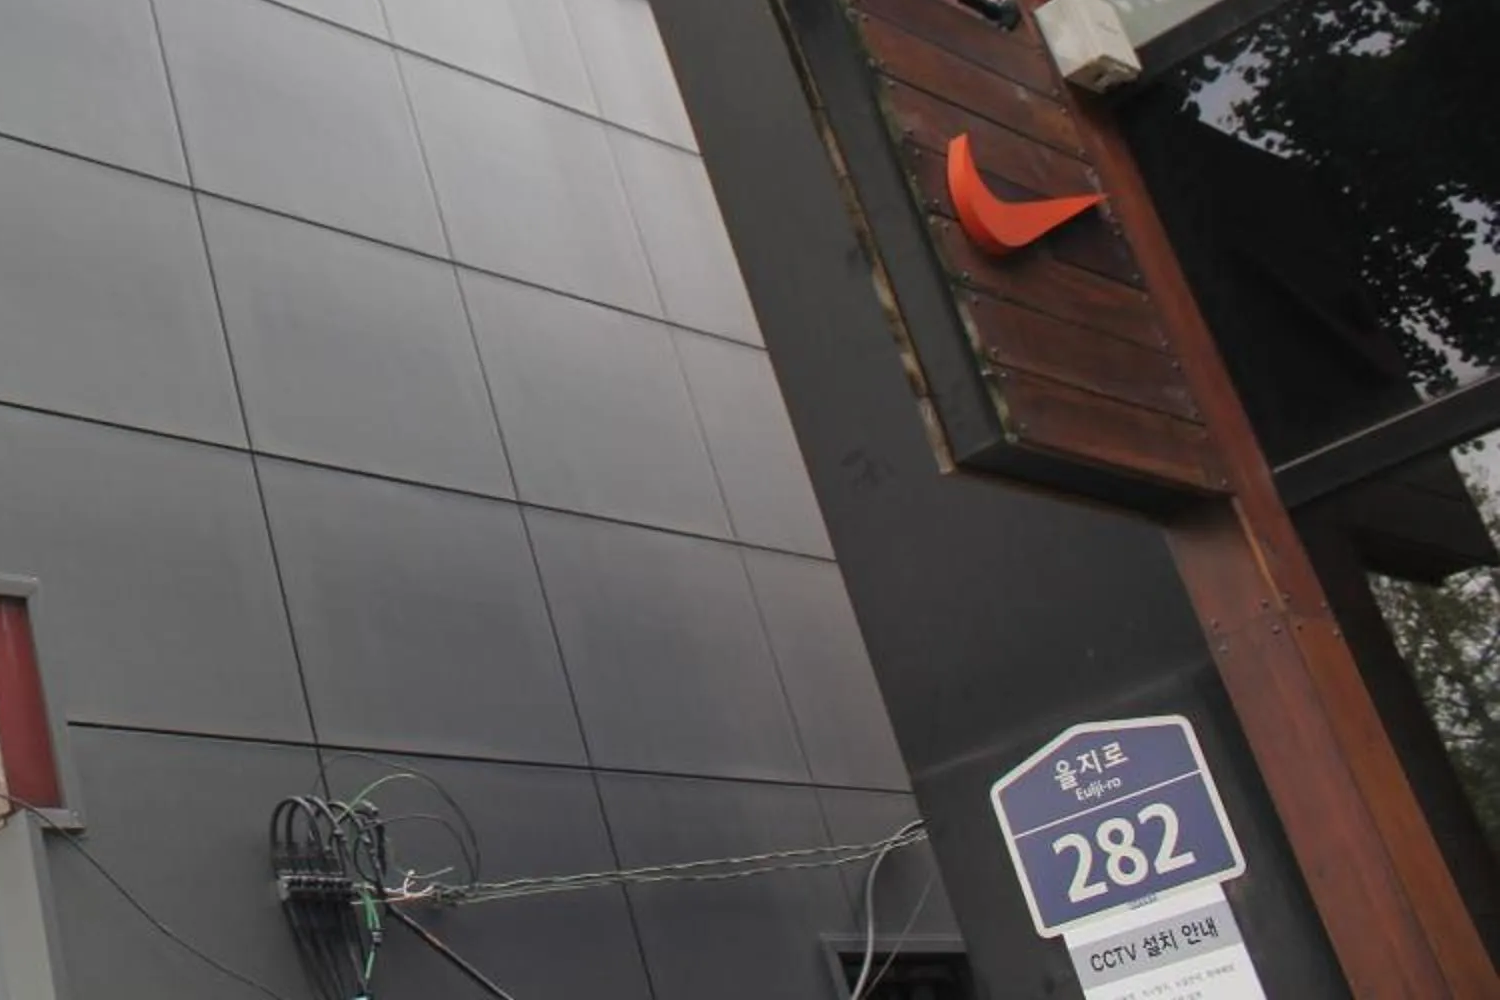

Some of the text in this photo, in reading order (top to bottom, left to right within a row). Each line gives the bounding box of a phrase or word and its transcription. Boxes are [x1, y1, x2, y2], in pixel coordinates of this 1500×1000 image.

[1054, 741, 1130, 791] 을지로
[1051, 803, 1197, 904] 282
[1090, 916, 1219, 972] CCTV 설치 안내
